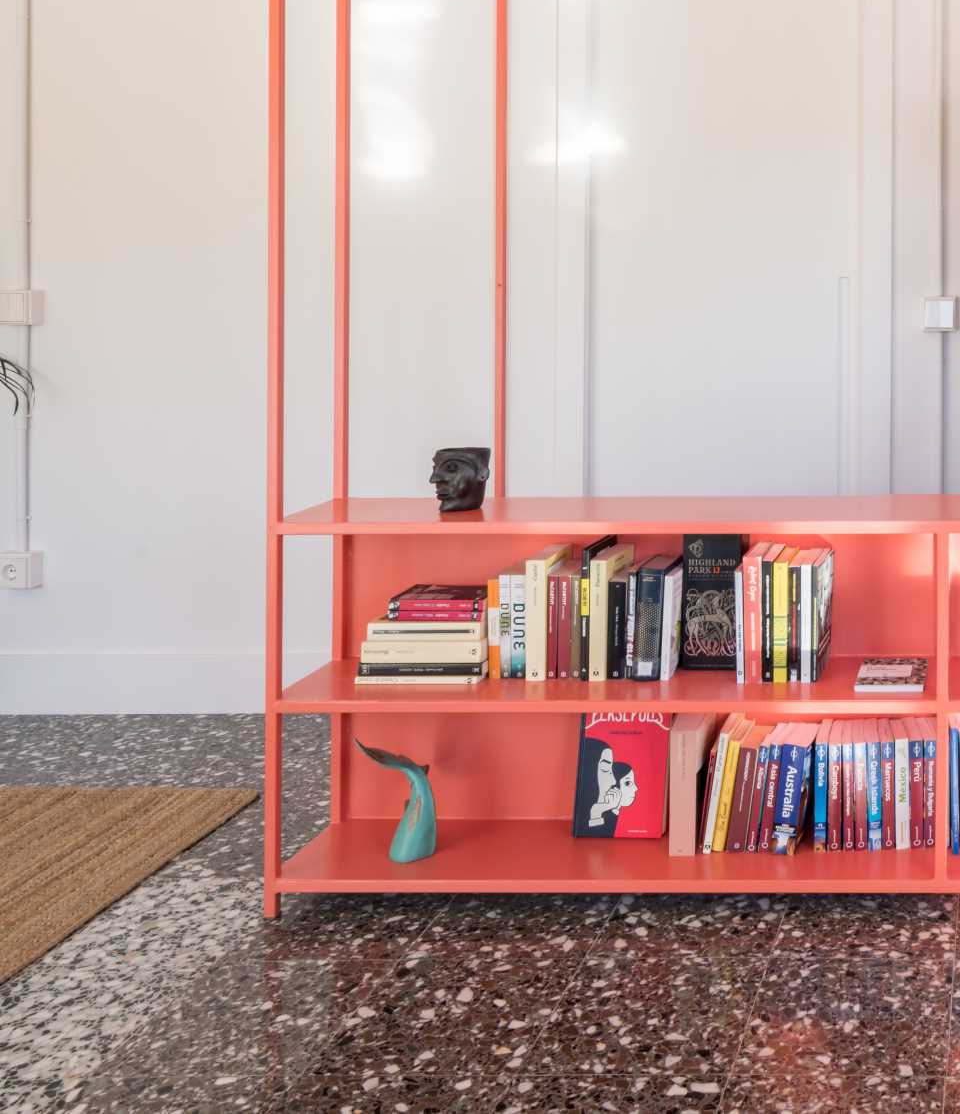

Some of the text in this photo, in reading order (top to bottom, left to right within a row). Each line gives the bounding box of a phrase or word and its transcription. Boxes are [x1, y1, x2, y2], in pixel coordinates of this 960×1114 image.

[688, 558, 736, 566] HIGHLAND
[688, 566, 711, 574] PARK
[500, 603, 510, 637] DUNE
[513, 603, 526, 651] DUNE
[766, 763, 778, 808] Asia central
[817, 762, 825, 787] Bolivia
[830, 765, 840, 800] Camboya
[870, 760, 879, 816] Greek Islands
[913, 761, 922, 782] Perú
[781, 765, 798, 818] Australia
[926, 792, 934, 817] Bulgaria
